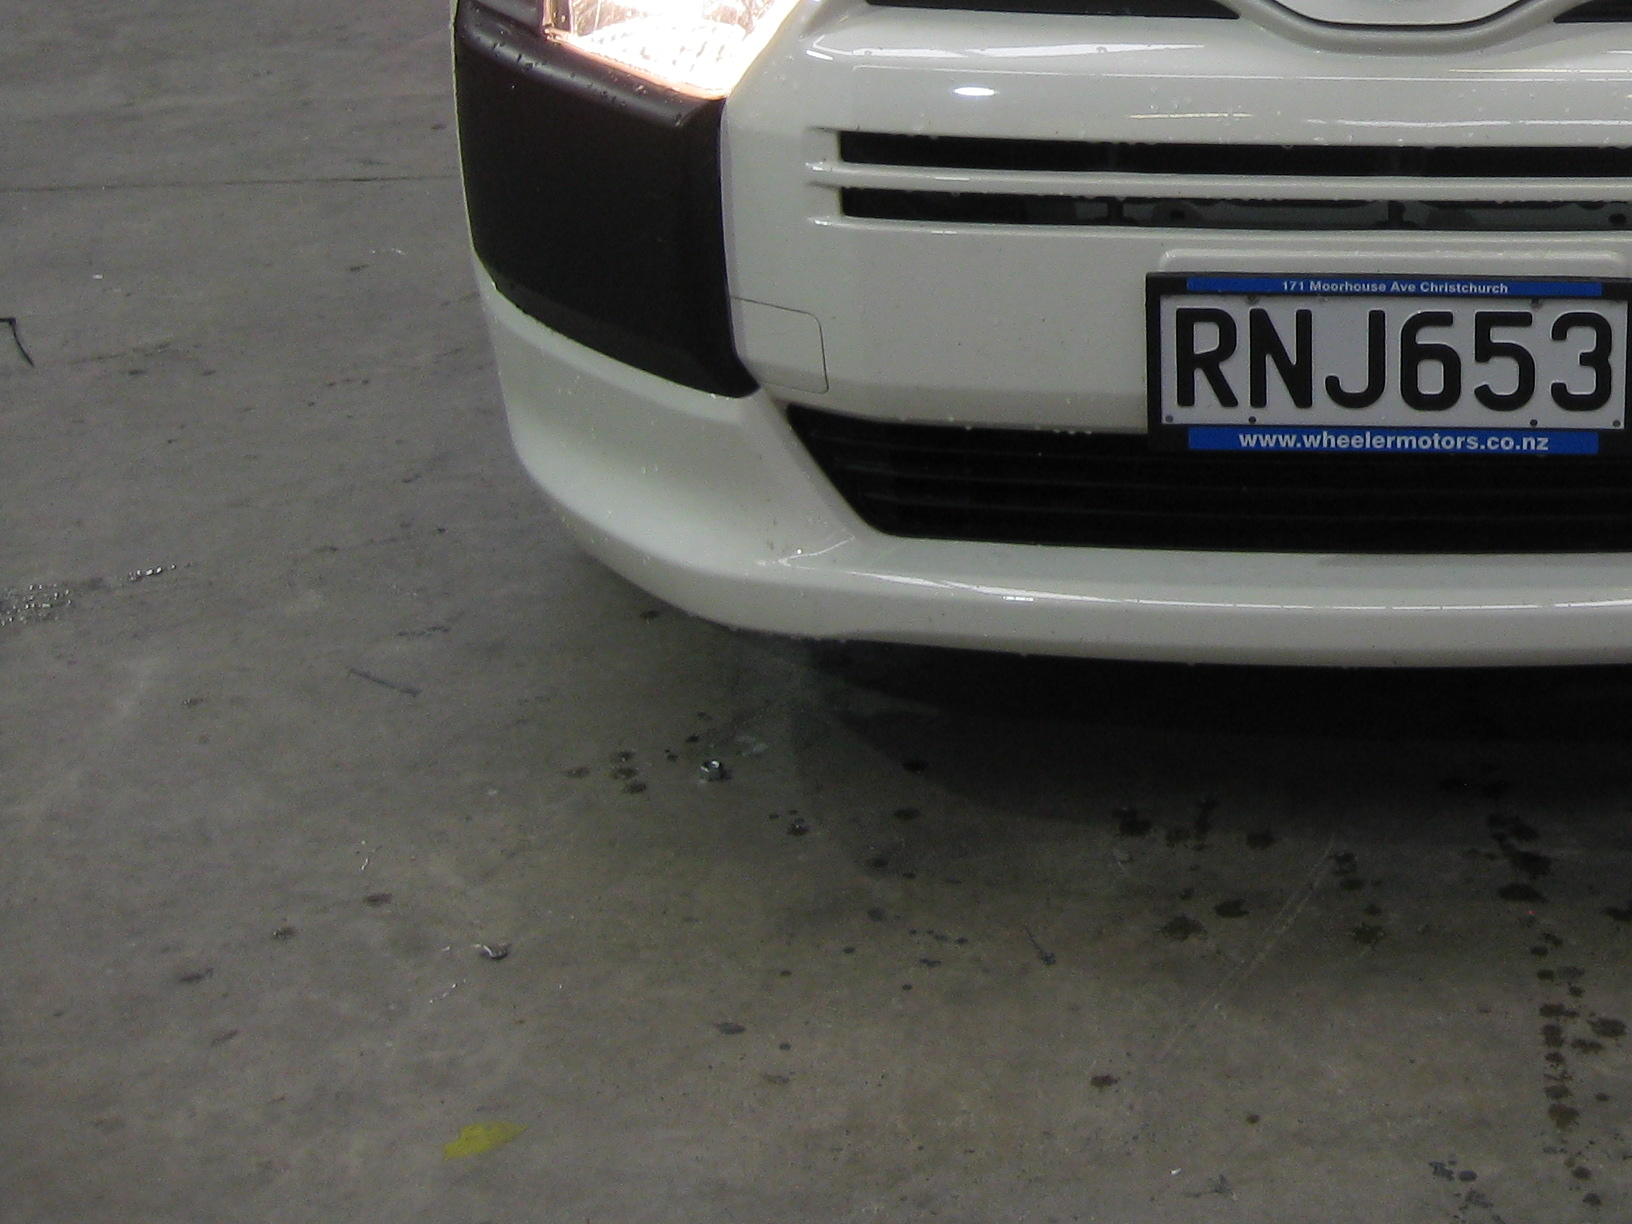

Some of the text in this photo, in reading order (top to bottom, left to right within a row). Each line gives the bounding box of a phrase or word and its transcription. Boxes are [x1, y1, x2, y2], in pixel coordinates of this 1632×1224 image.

[1282, 281, 1508, 294] 171 Moorhouse Ave Christchurch
[1176, 308, 1612, 411] RNJ653
[1239, 430, 1548, 451] www.wheelermotors.co.nz
